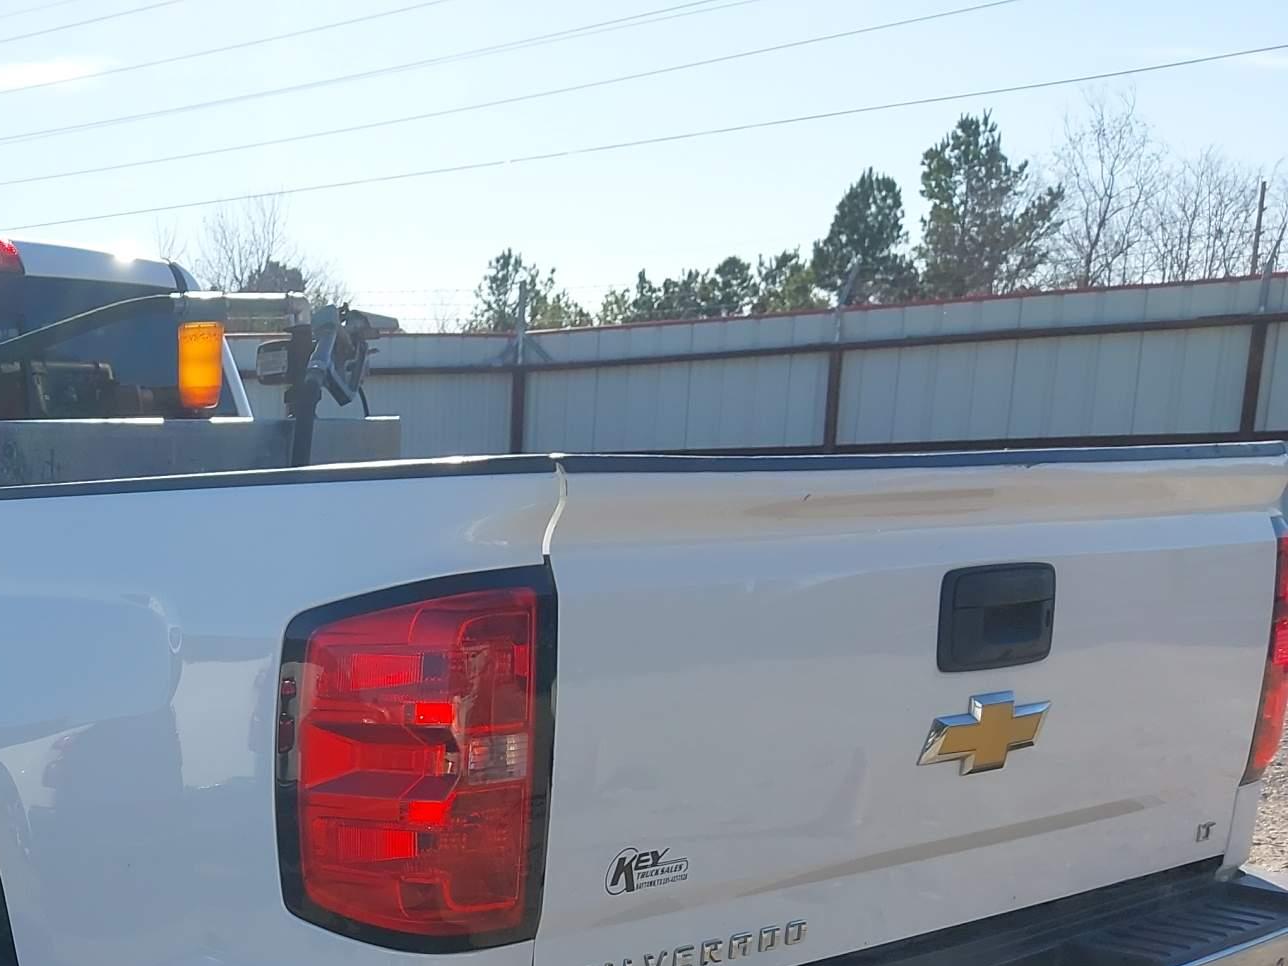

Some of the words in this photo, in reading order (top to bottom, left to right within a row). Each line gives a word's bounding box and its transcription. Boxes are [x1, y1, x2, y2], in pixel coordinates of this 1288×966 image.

[609, 847, 670, 892] KEY
[636, 868, 660, 880] TRUCK
[660, 863, 684, 875] SALES
